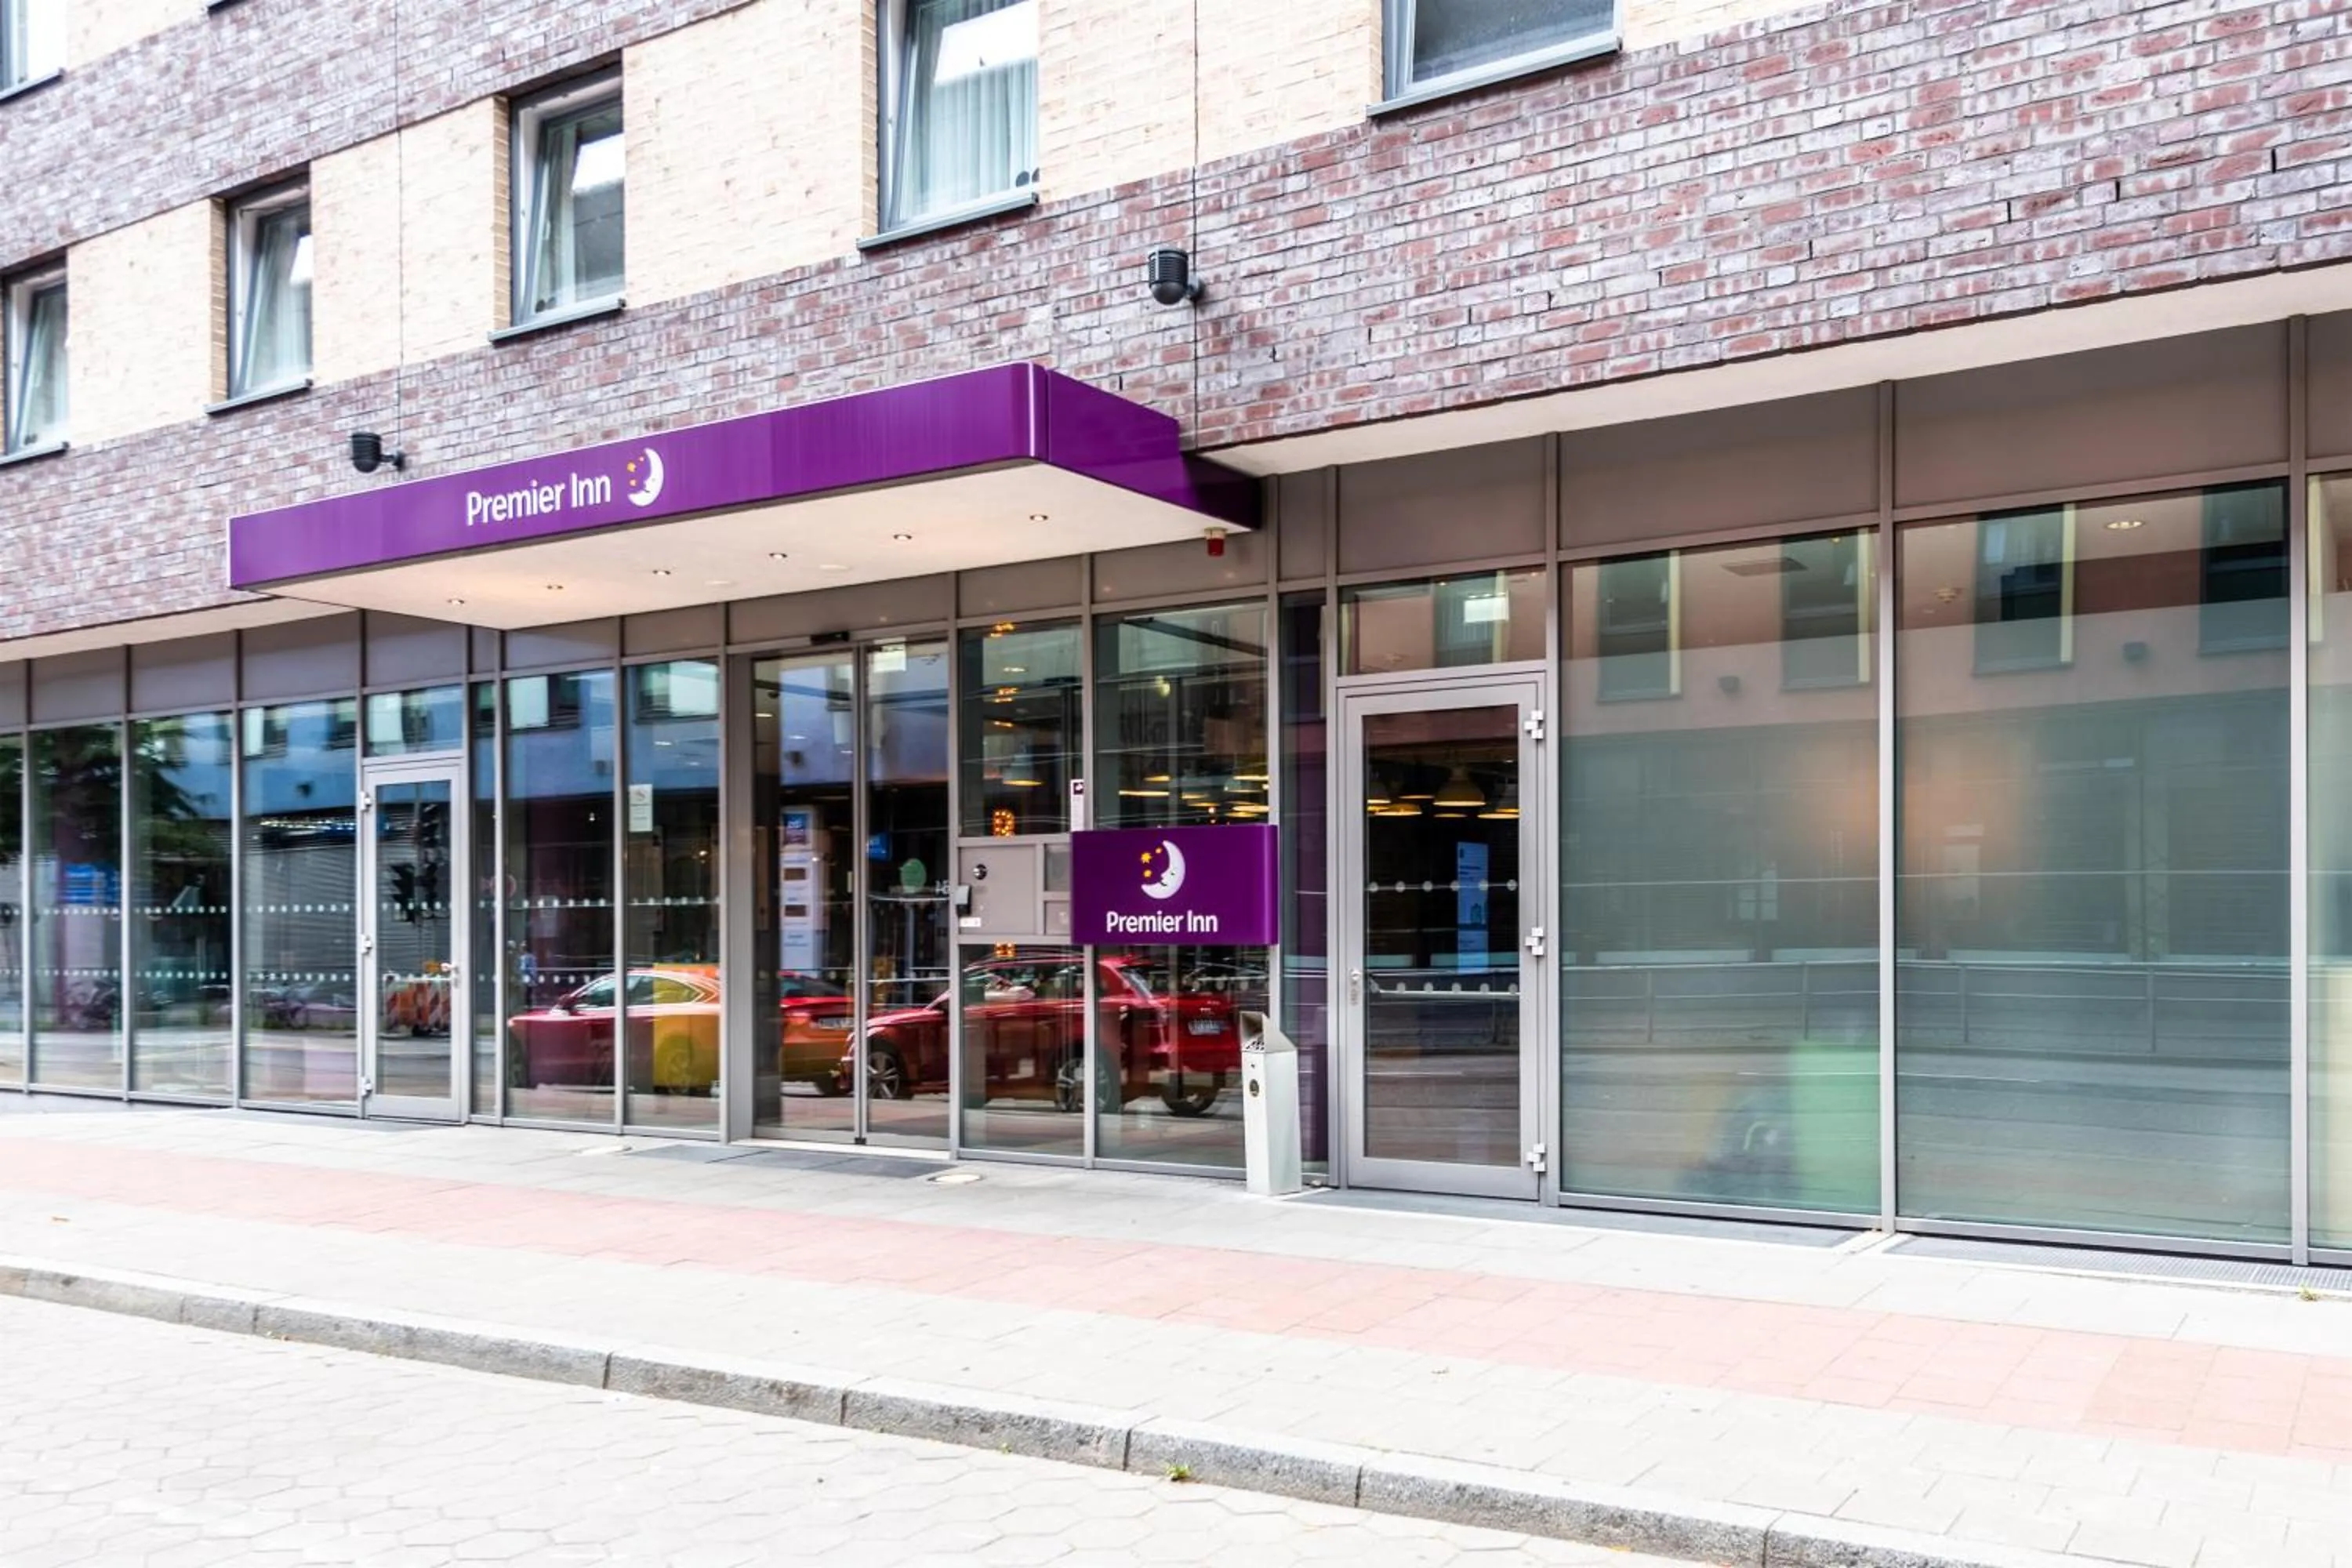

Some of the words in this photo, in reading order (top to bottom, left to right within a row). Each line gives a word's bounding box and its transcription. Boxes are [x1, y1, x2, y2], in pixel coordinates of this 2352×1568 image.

[466, 479, 565, 526] Premier
[571, 472, 611, 508] Inn
[1106, 910, 1184, 933] Premier
[1187, 909, 1218, 933] Inn
